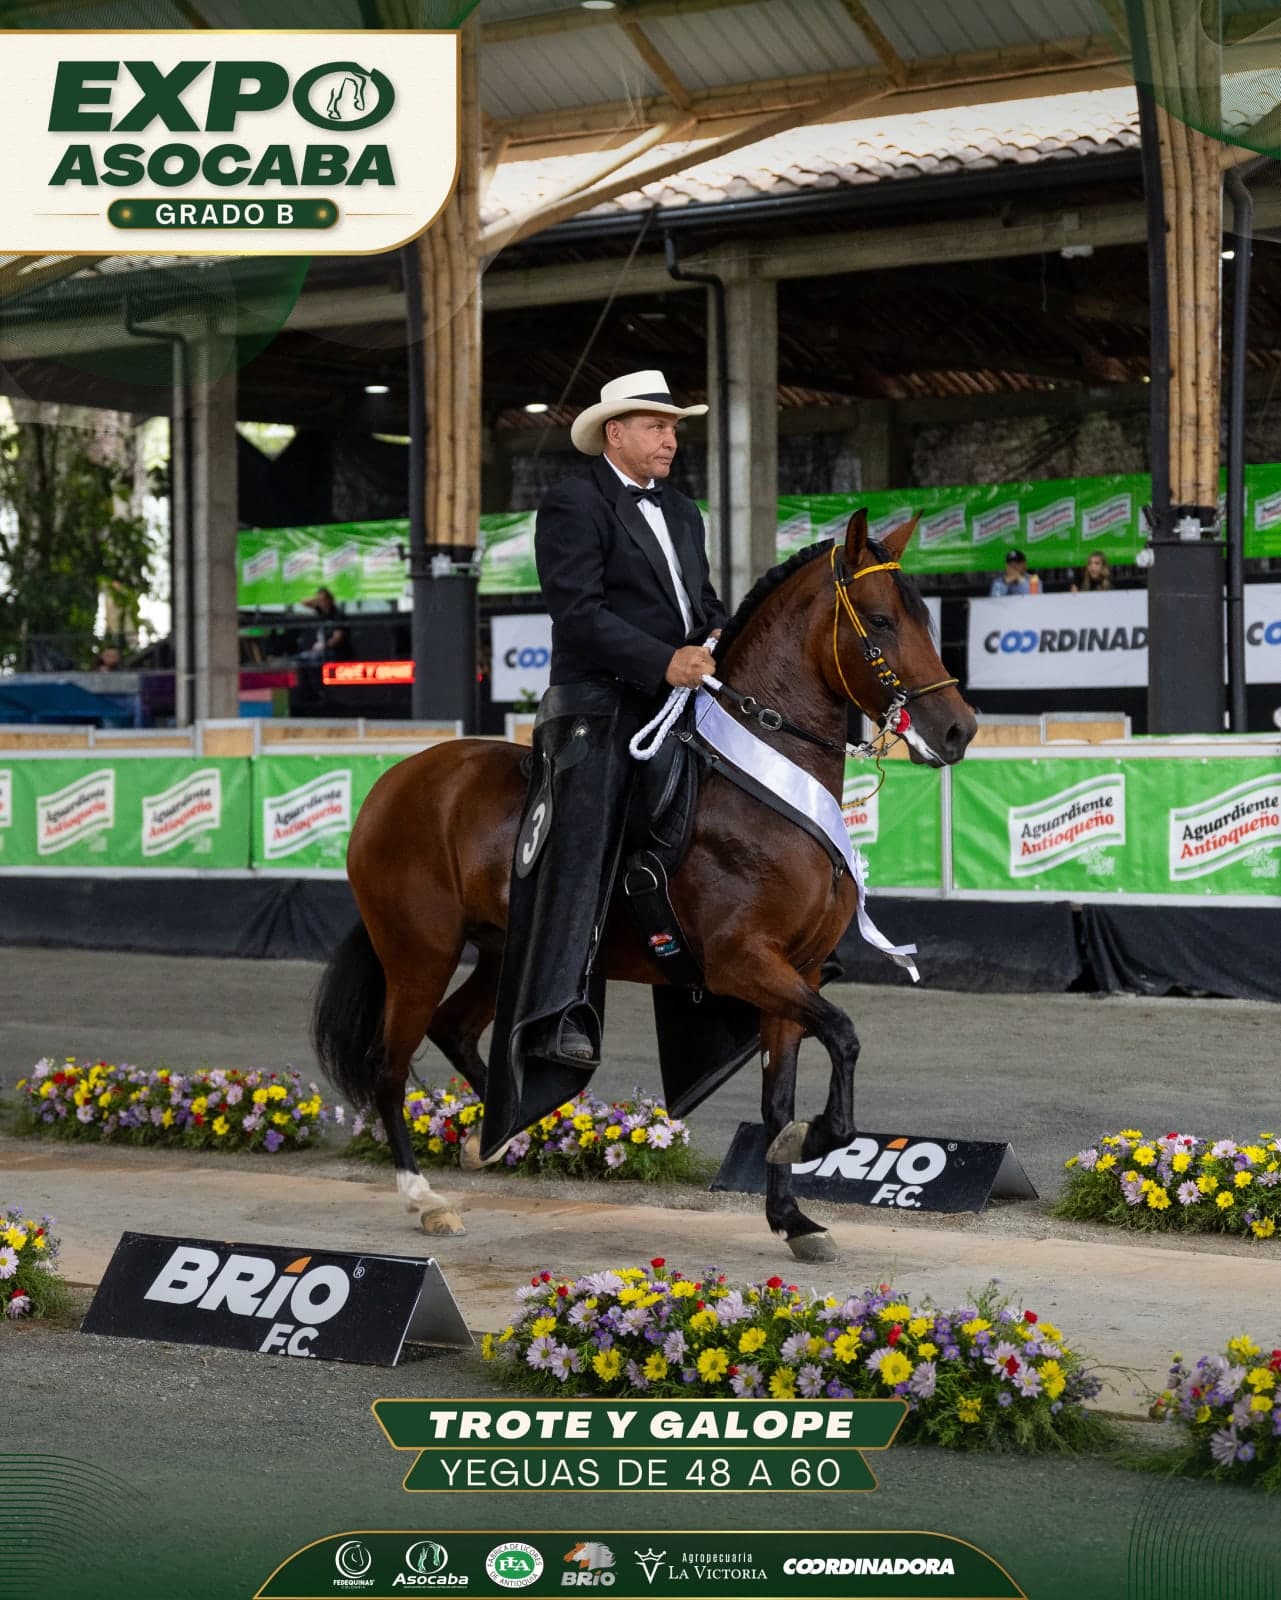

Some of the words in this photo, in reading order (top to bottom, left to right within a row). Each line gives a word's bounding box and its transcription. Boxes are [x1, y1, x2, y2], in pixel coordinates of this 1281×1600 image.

[522, 803, 546, 865] 3
[1021, 796, 1113, 840] Aguardiente
[1021, 811, 1115, 857] Antioqueño
[1180, 811, 1280, 860] Antioqueño
[1183, 796, 1279, 841] Aguardiente
